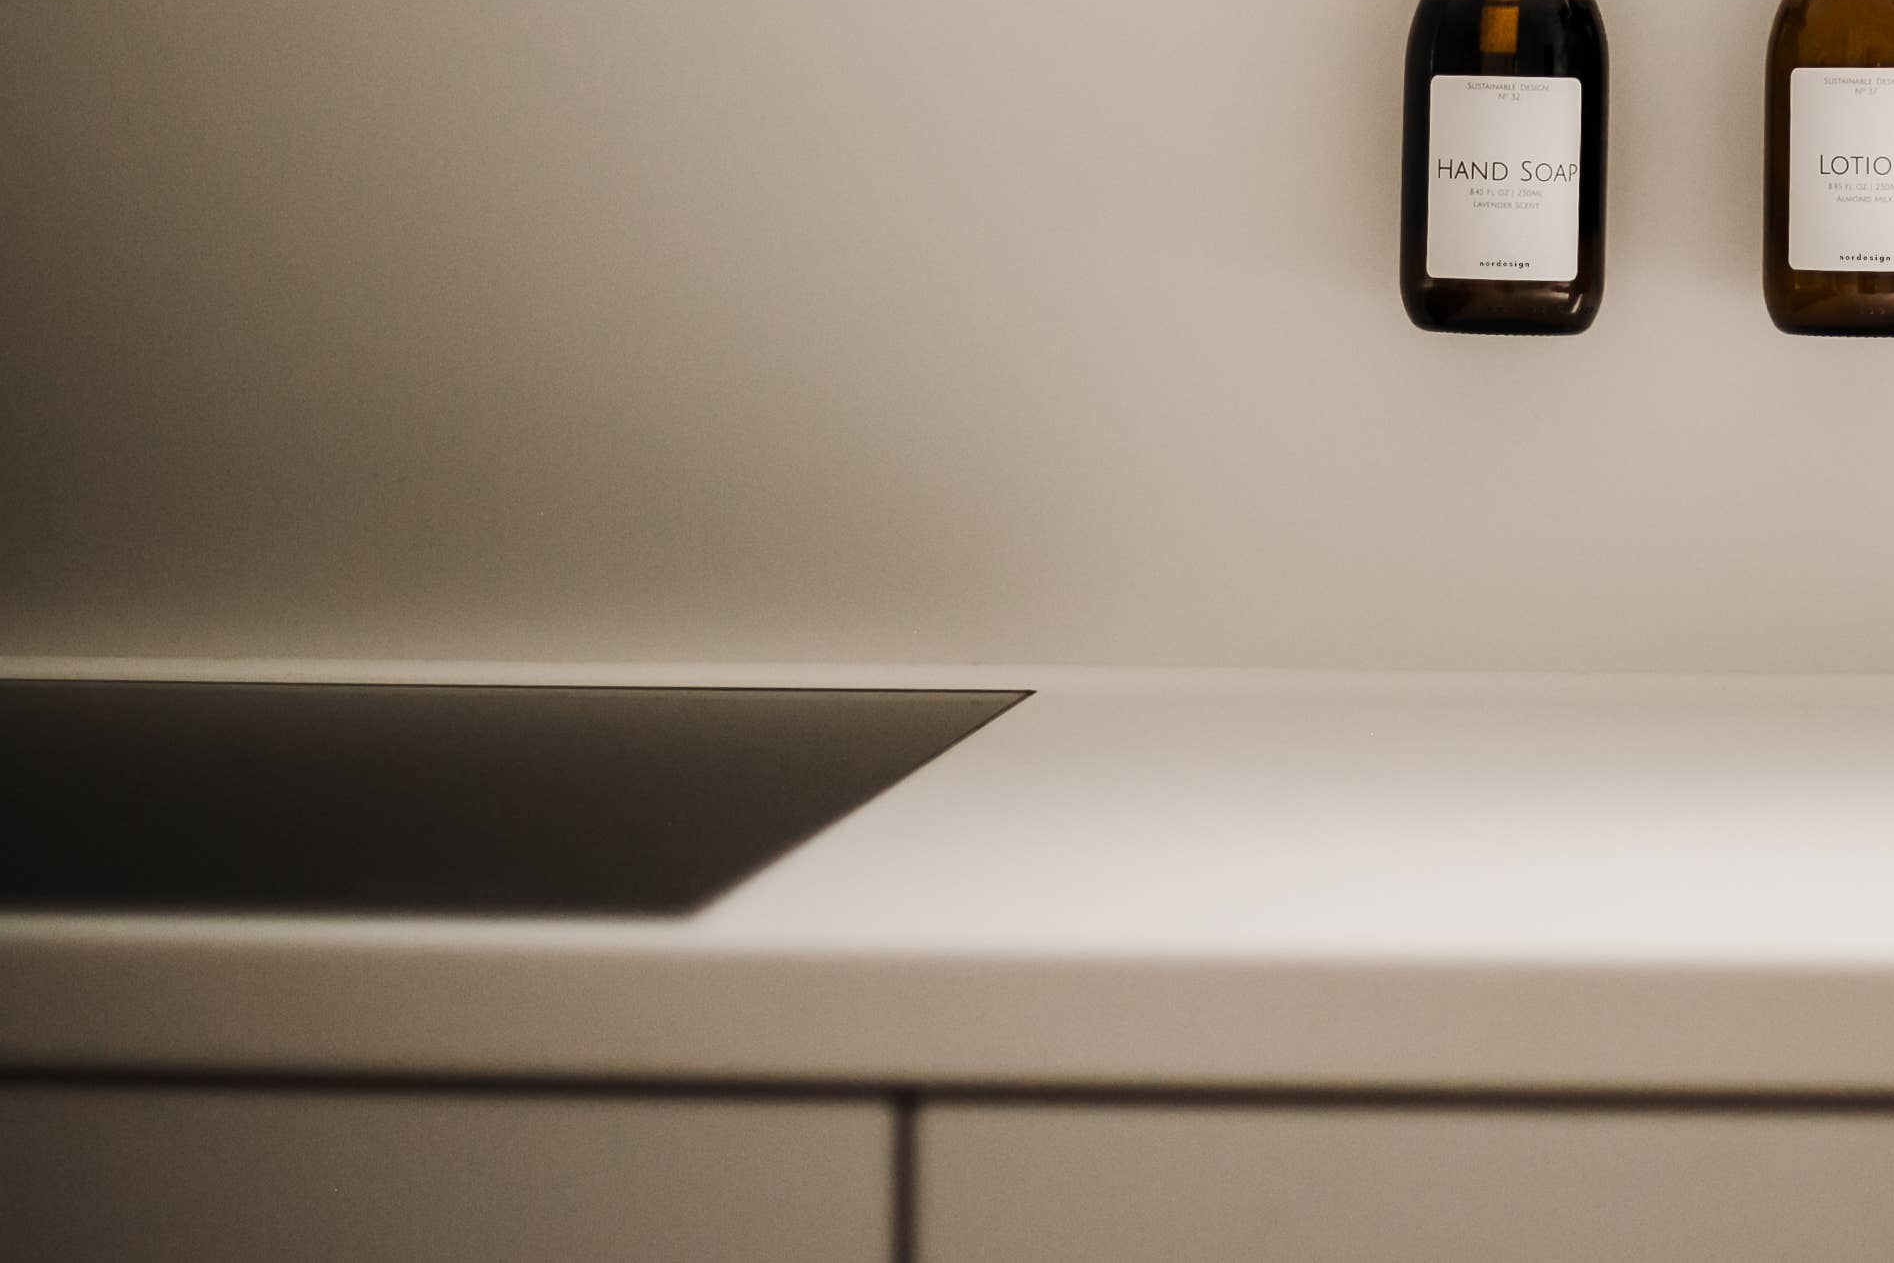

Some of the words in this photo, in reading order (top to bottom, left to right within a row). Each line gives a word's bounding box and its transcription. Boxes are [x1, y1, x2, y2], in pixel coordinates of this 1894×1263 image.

[1467, 82, 1516, 91] SUSTAINABLE
[1438, 159, 1509, 181] HAND
[1520, 160, 1578, 183] SOAP
[1839, 253, 1891, 262] nordesign
[1479, 260, 1530, 269] nordesign
